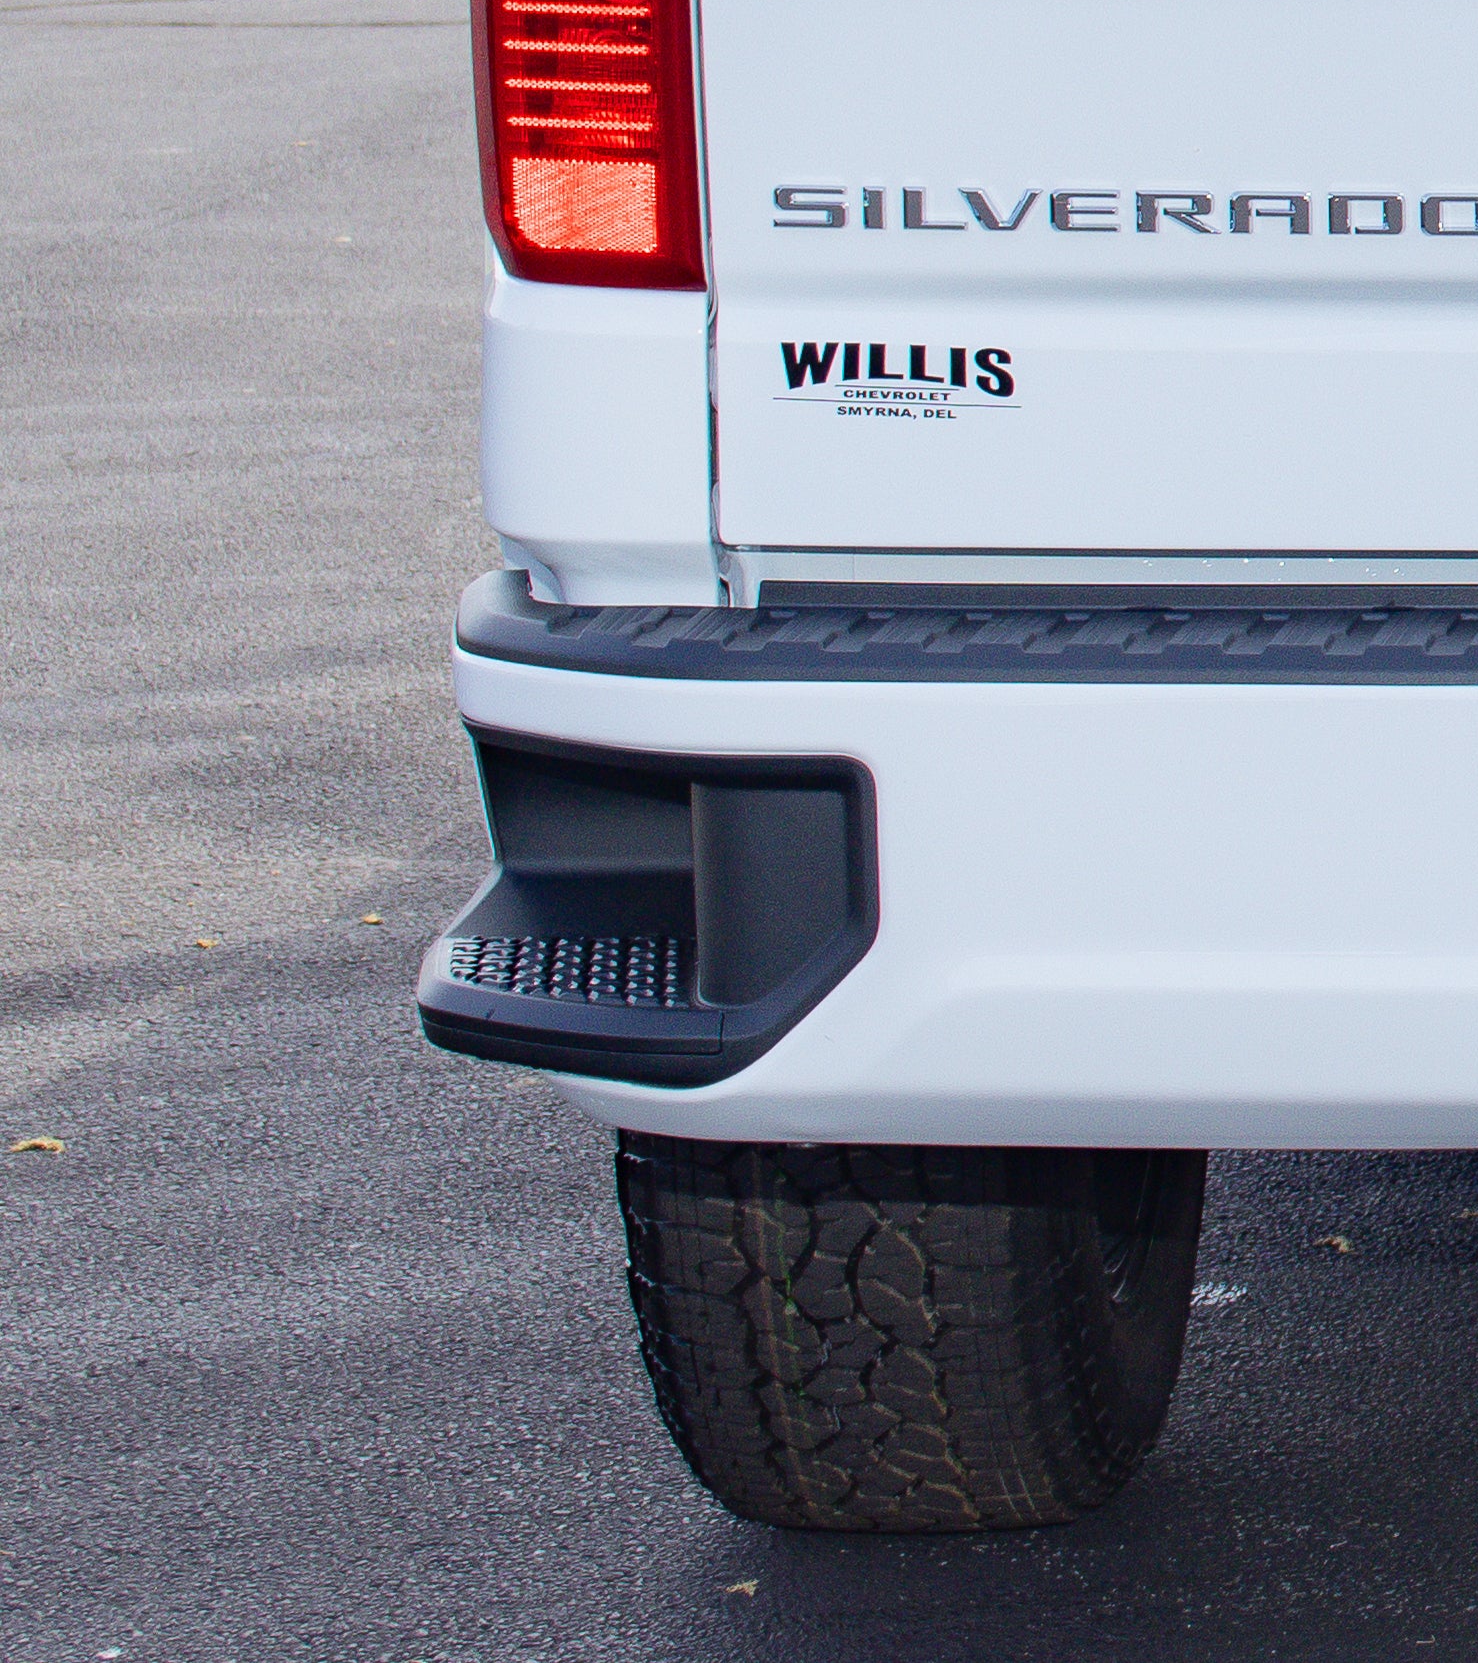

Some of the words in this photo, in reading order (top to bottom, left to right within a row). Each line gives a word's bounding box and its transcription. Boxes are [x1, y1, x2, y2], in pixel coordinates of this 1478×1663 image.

[780, 341, 1016, 398] WILLIS
[843, 388, 951, 402] CHEVROLET
[837, 405, 917, 420] SMYRNA,
[922, 408, 957, 419] DEL
